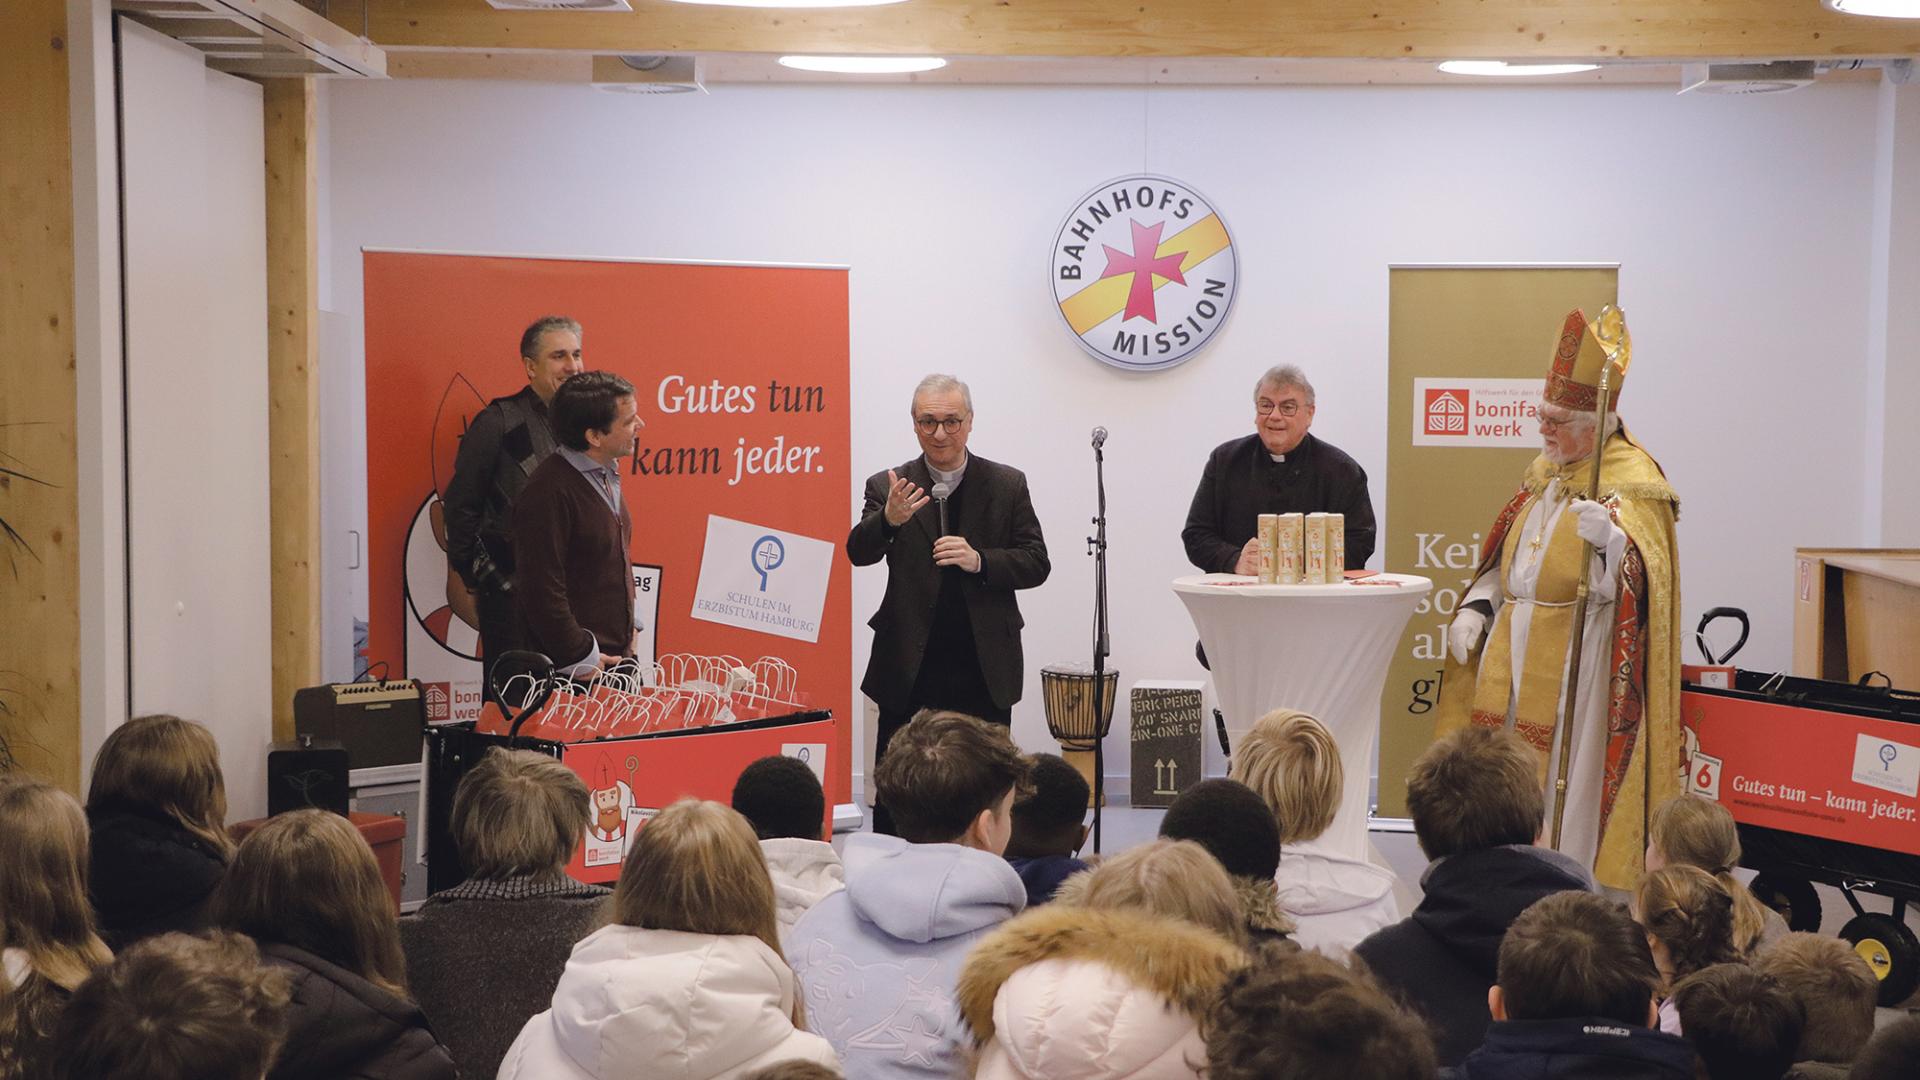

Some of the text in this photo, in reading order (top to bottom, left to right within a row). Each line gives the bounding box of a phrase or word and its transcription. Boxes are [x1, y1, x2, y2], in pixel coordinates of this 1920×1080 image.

[1060, 186, 1194, 280] BAHNHOFS
[1112, 278, 1226, 356] MISSION
[657, 375, 826, 414] Gutes tun
[1475, 400, 1537, 418] bonifa
[1474, 420, 1523, 437] werk
[631, 436, 824, 486] kann jeder.
[1414, 533, 1481, 569] Kei
[635, 576, 652, 592] ag
[697, 599, 815, 633] ERZBISTUM HAMBURG
[726, 591, 791, 614] SCHULEN IM
[1412, 623, 1450, 660] al
[455, 690, 481, 704] bon
[1131, 698, 1161, 713] ERK
[1408, 670, 1444, 714] gl
[454, 708, 481, 719] wer
[1696, 763, 1712, 788] 6
[1732, 775, 1775, 797] Gutes
[1779, 784, 1806, 803] tun
[1825, 790, 1867, 813] kann
[1868, 799, 1917, 822] jeder.
